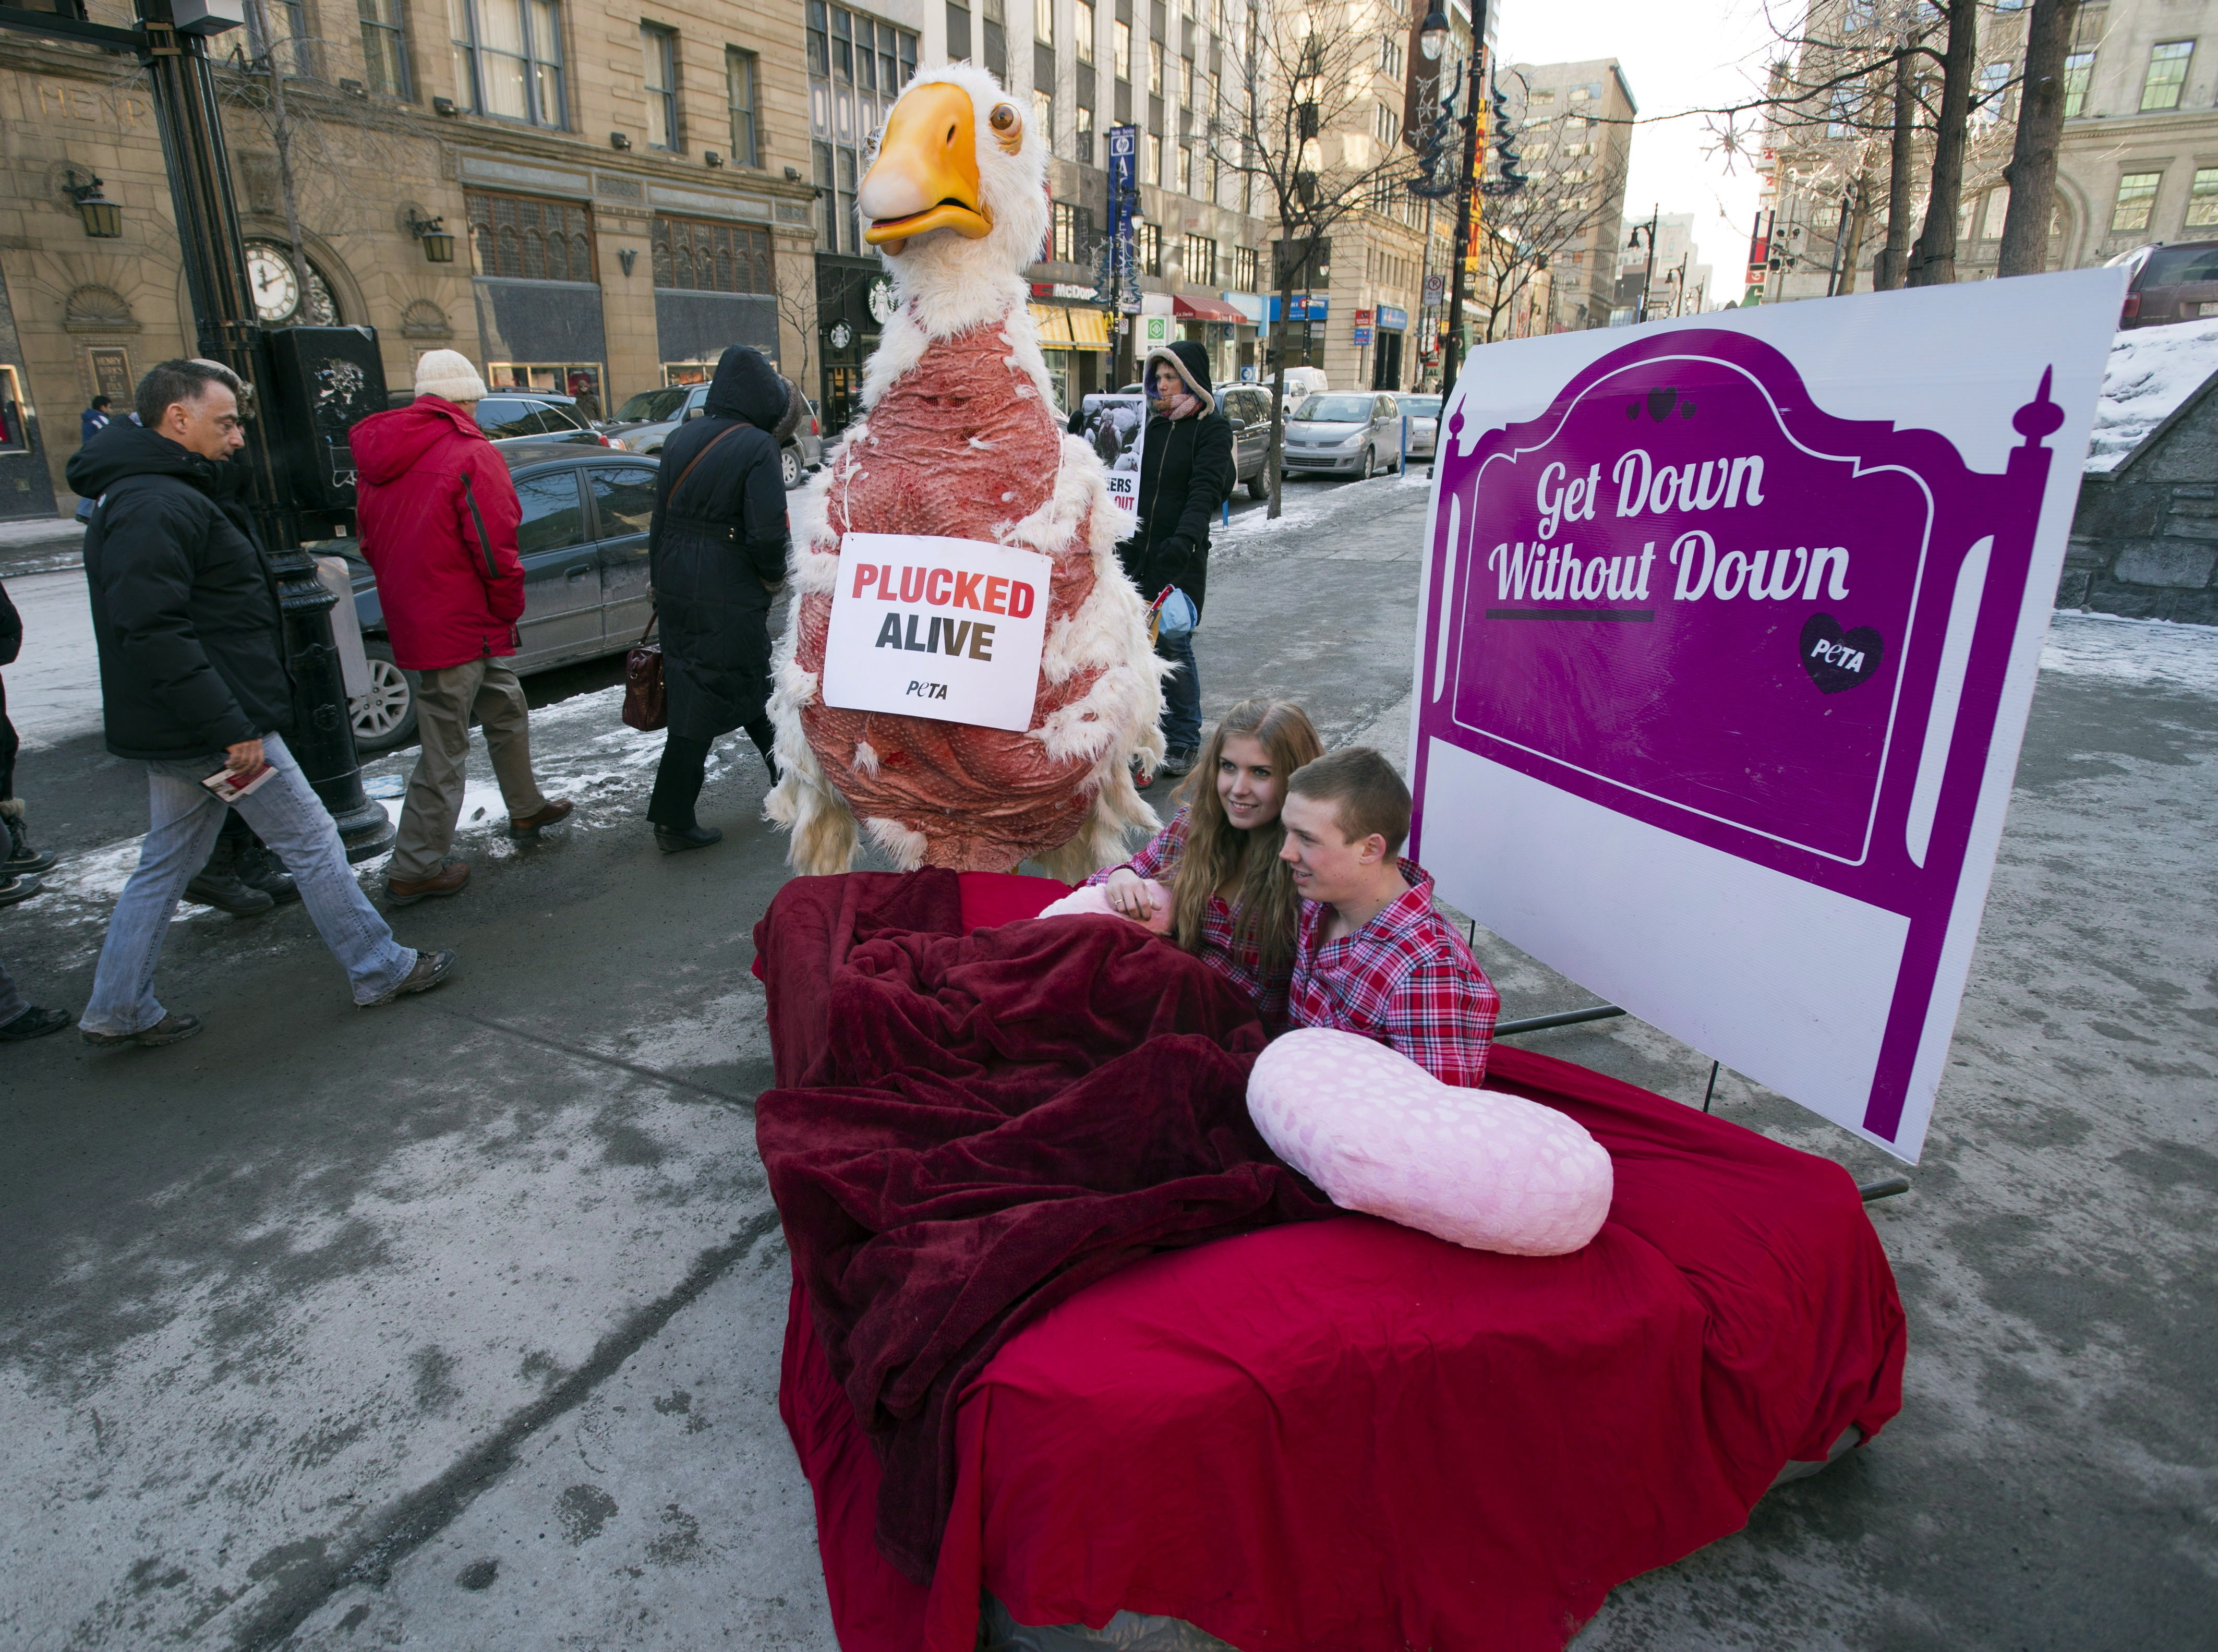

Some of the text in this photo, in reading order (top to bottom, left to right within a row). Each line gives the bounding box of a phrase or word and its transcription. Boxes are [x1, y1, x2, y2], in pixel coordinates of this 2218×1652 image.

[37, 84, 158, 129] HENR
[1105, 477, 1131, 493] ERS
[1537, 449, 1765, 540] Get Down
[852, 563, 1035, 619] PLUCKED
[1488, 529, 1850, 601] Without Down
[875, 612, 996, 661] ALIVE
